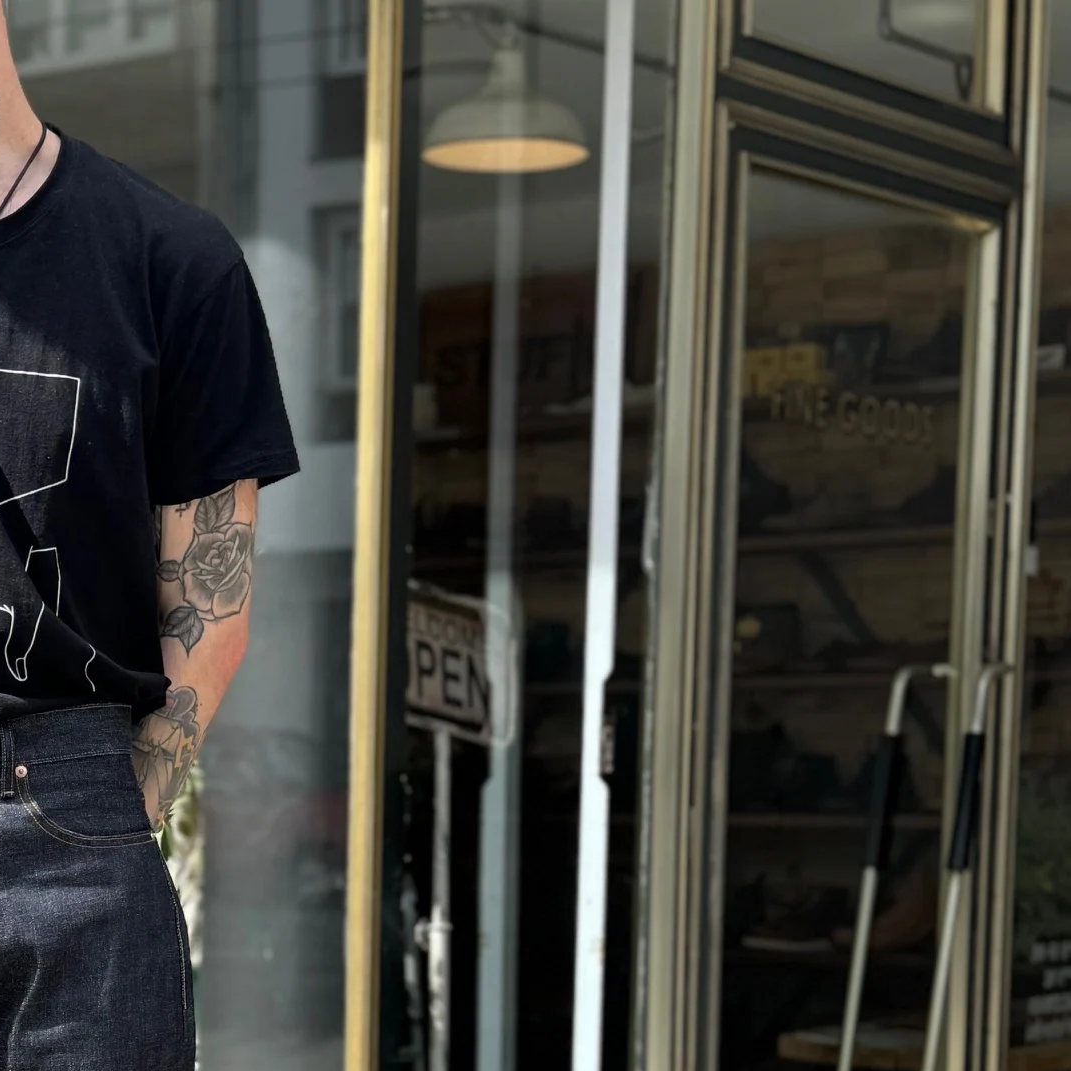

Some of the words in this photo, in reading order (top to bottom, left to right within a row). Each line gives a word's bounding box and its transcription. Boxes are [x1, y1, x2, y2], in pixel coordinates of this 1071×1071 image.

[770, 384, 830, 428] FINE
[836, 390, 935, 443] GOODS
[415, 638, 492, 718] PEN
